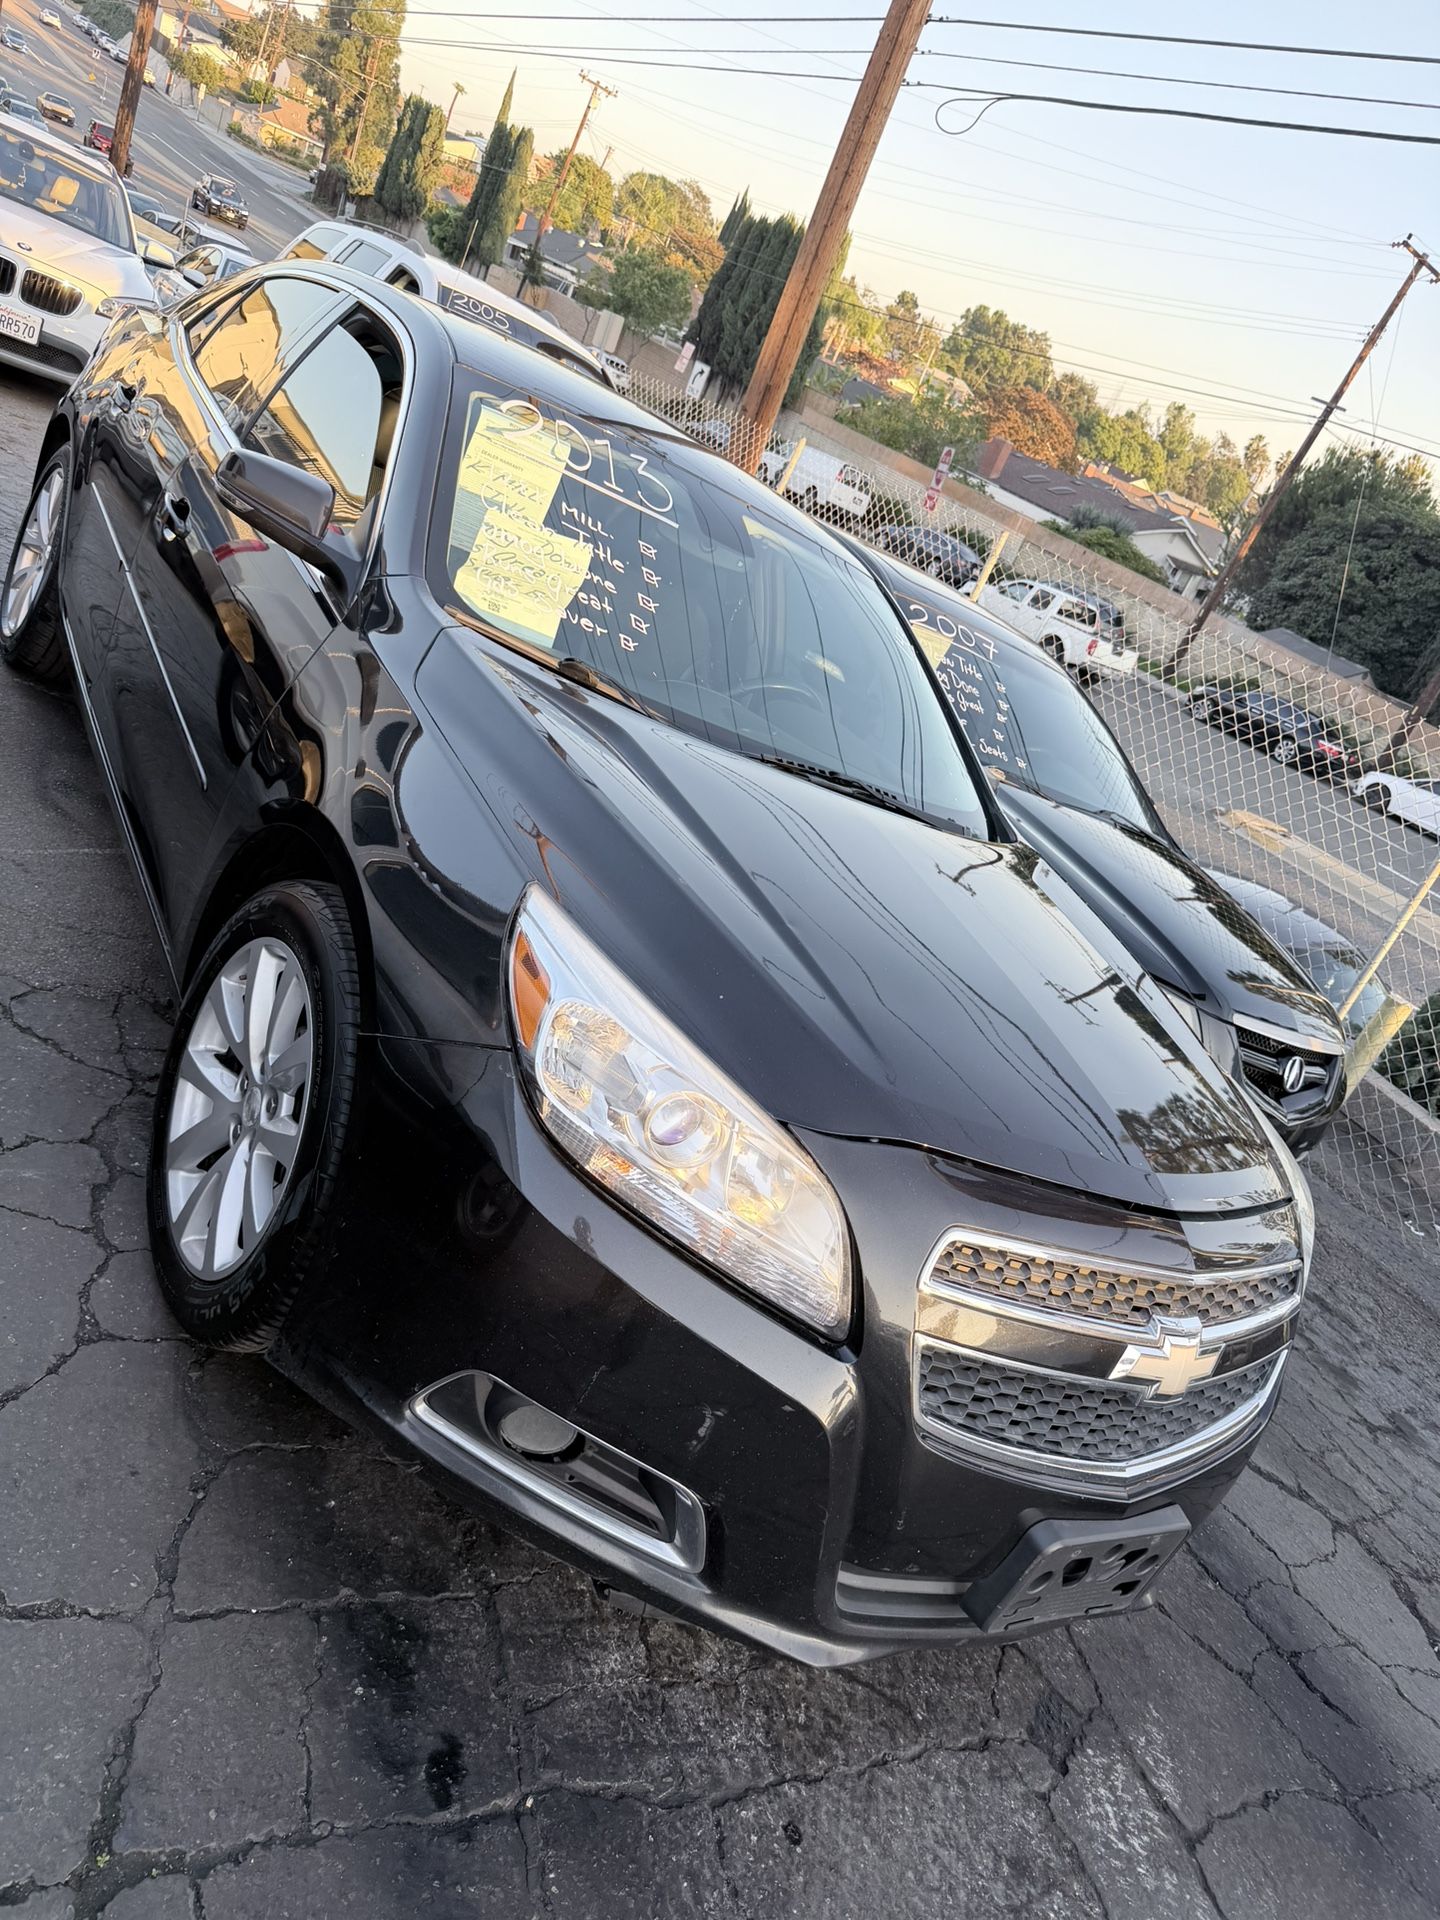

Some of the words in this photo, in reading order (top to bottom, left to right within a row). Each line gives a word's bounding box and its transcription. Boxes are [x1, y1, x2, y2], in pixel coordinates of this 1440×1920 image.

[0, 314, 36, 339] RR570
[452, 292, 510, 330] 2005
[500, 399, 673, 513] 2013
[909, 603, 999, 660] 2007
